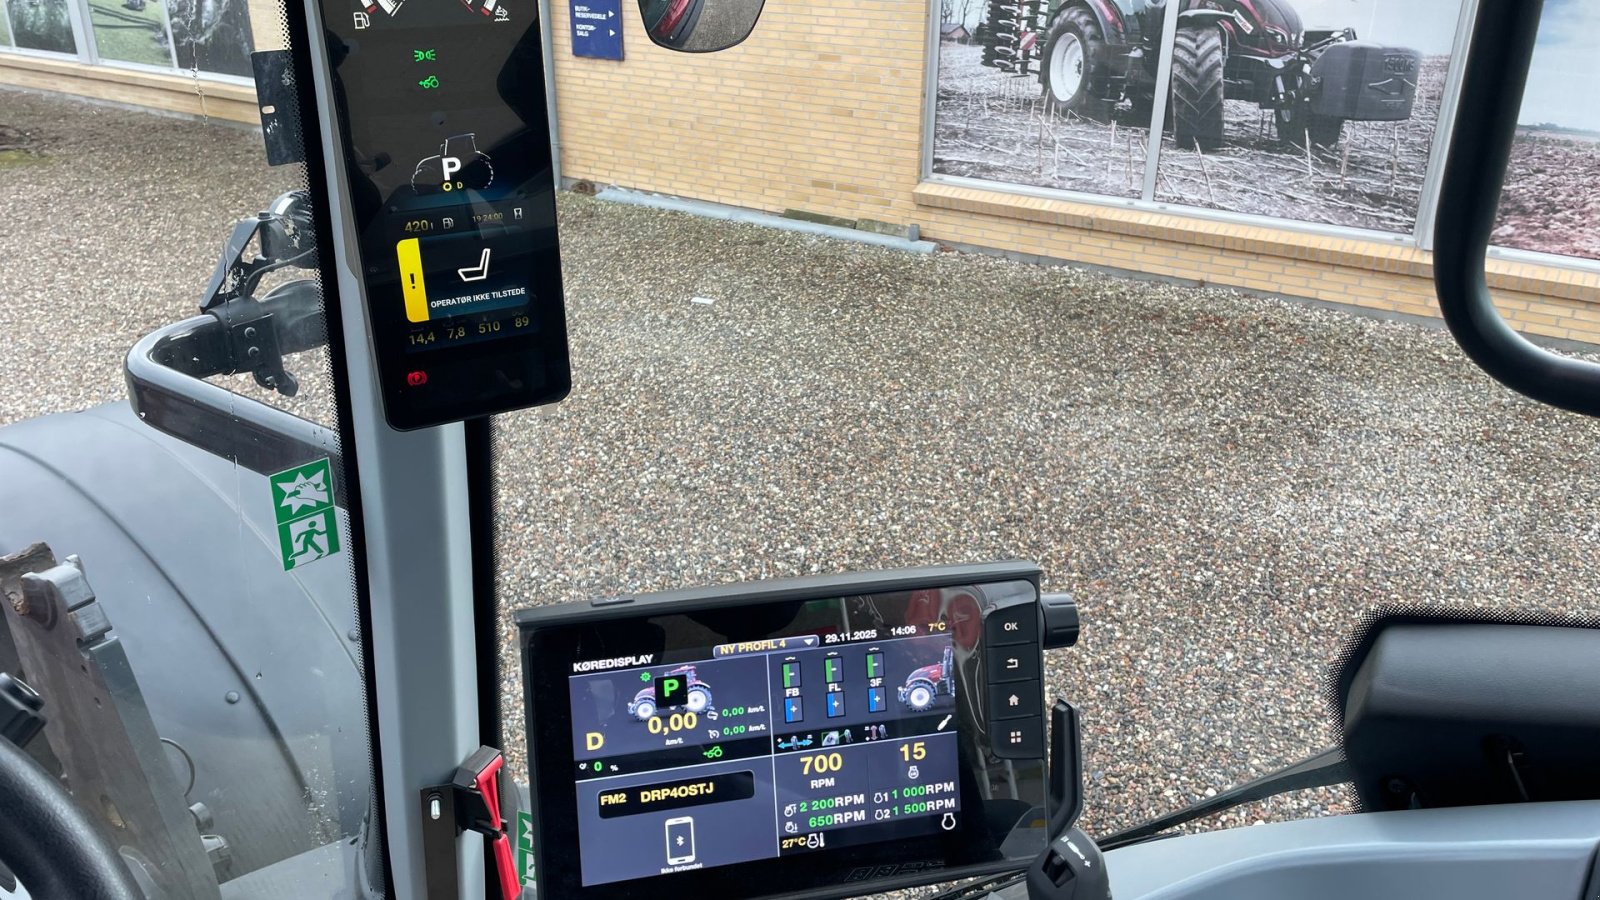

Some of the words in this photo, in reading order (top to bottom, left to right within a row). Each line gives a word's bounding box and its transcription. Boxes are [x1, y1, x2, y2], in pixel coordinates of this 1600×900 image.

[441, 157, 462, 180] P
[472, 212, 503, 223] 19:24:00
[404, 220, 429, 232] 420
[430, 294, 472, 308] OPERATØR
[473, 292, 490, 302] IKKE
[491, 287, 526, 299] TILSTEDE
[478, 321, 501, 334] 510
[515, 316, 529, 328] 89
[409, 331, 435, 345] 14,4
[447, 327, 465, 339] 7,8
[890, 625, 917, 636] 14:06
[928, 622, 946, 632] 7°C
[1004, 622, 1019, 631] OK
[825, 629, 877, 643] 29.11.2025
[720, 645, 736, 655] NY
[738, 640, 777, 653] PROFIL
[779, 639, 786, 648] 4
[573, 654, 654, 672] KØREDISPLAY
[663, 679, 679, 697] P
[828, 683, 841, 692] FL
[870, 678, 882, 687] 3F
[785, 688, 800, 697] FB
[722, 706, 744, 717] 0,00
[648, 711, 697, 736] 0,00
[723, 725, 745, 736] 0,00
[586, 732, 604, 750] D
[900, 742, 926, 761] 15
[800, 752, 842, 775] 700
[810, 777, 835, 789] RPM
[600, 793, 627, 806] FM2
[781, 837, 806, 849] 27°C
